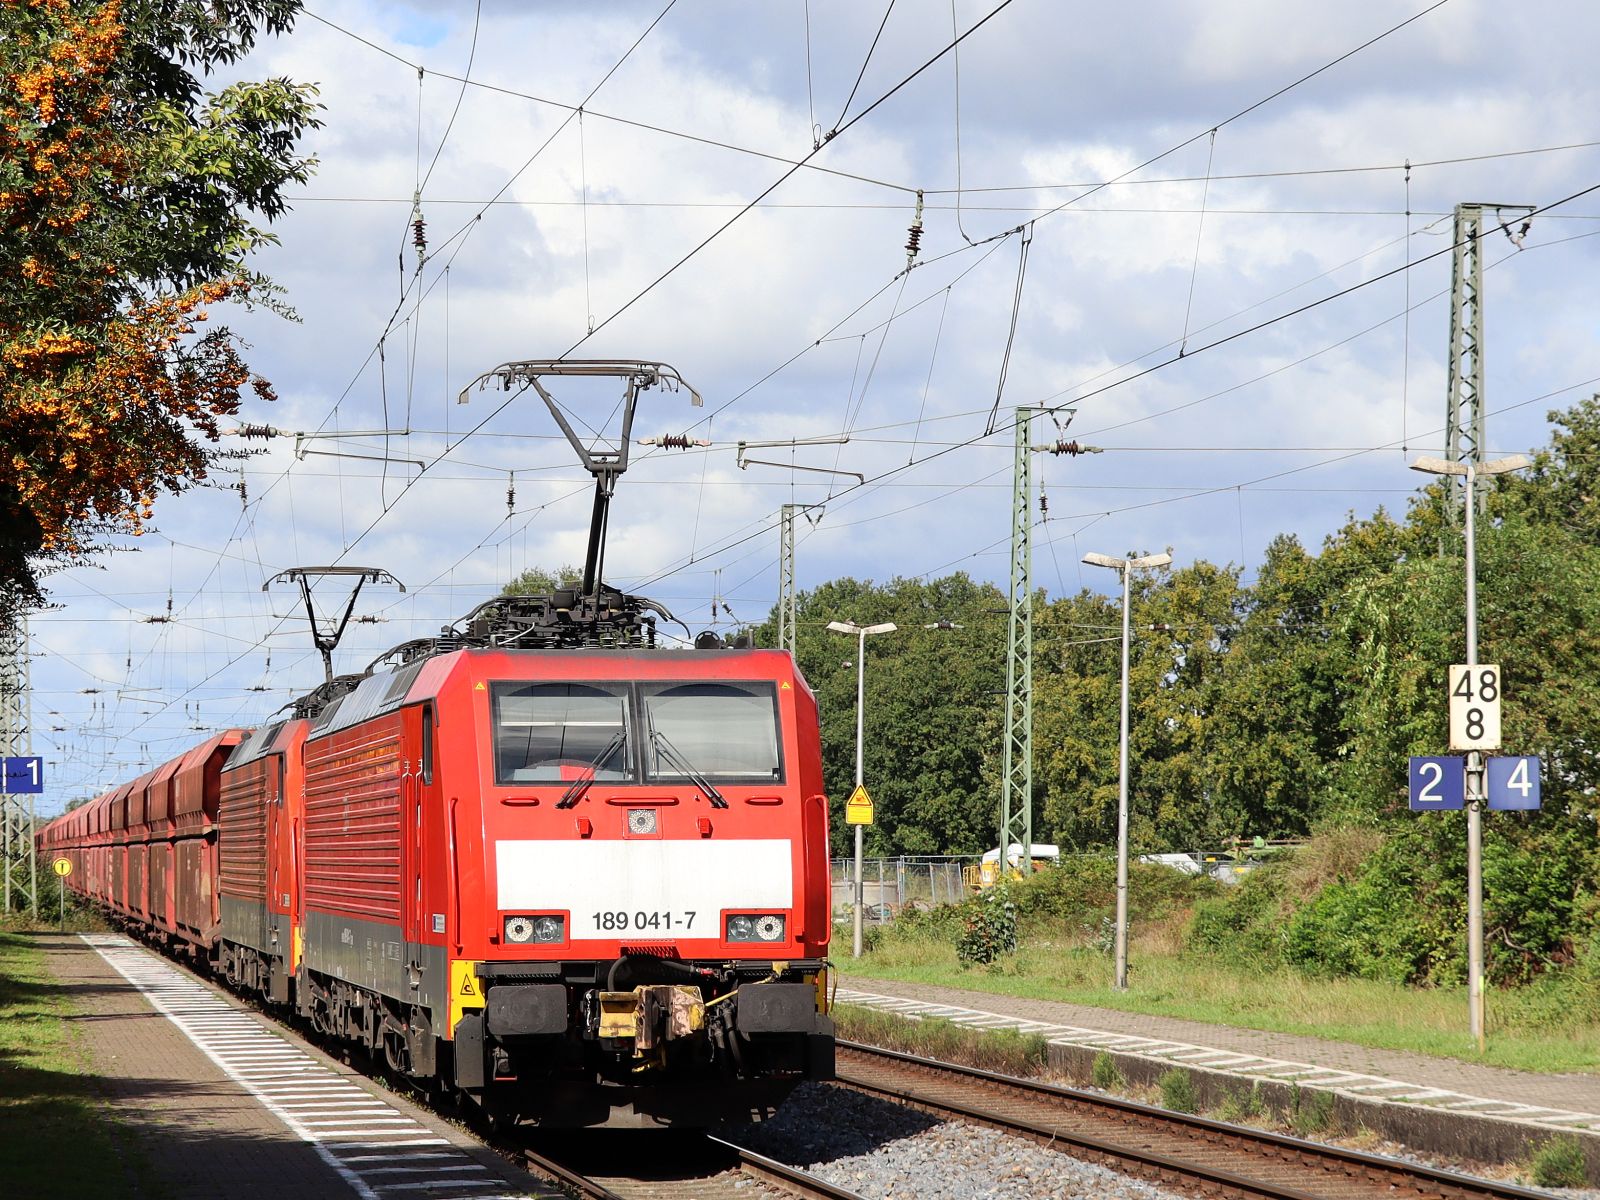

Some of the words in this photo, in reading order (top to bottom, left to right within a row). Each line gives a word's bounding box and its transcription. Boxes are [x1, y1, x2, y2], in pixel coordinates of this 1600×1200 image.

[1452, 670, 1498, 703] 48
[1465, 708, 1485, 741] 8
[26, 759, 38, 786] 1
[1418, 762, 1443, 802] 2
[1507, 758, 1533, 797] 4
[592, 911, 629, 930] 189
[634, 911, 697, 930] 041-7
